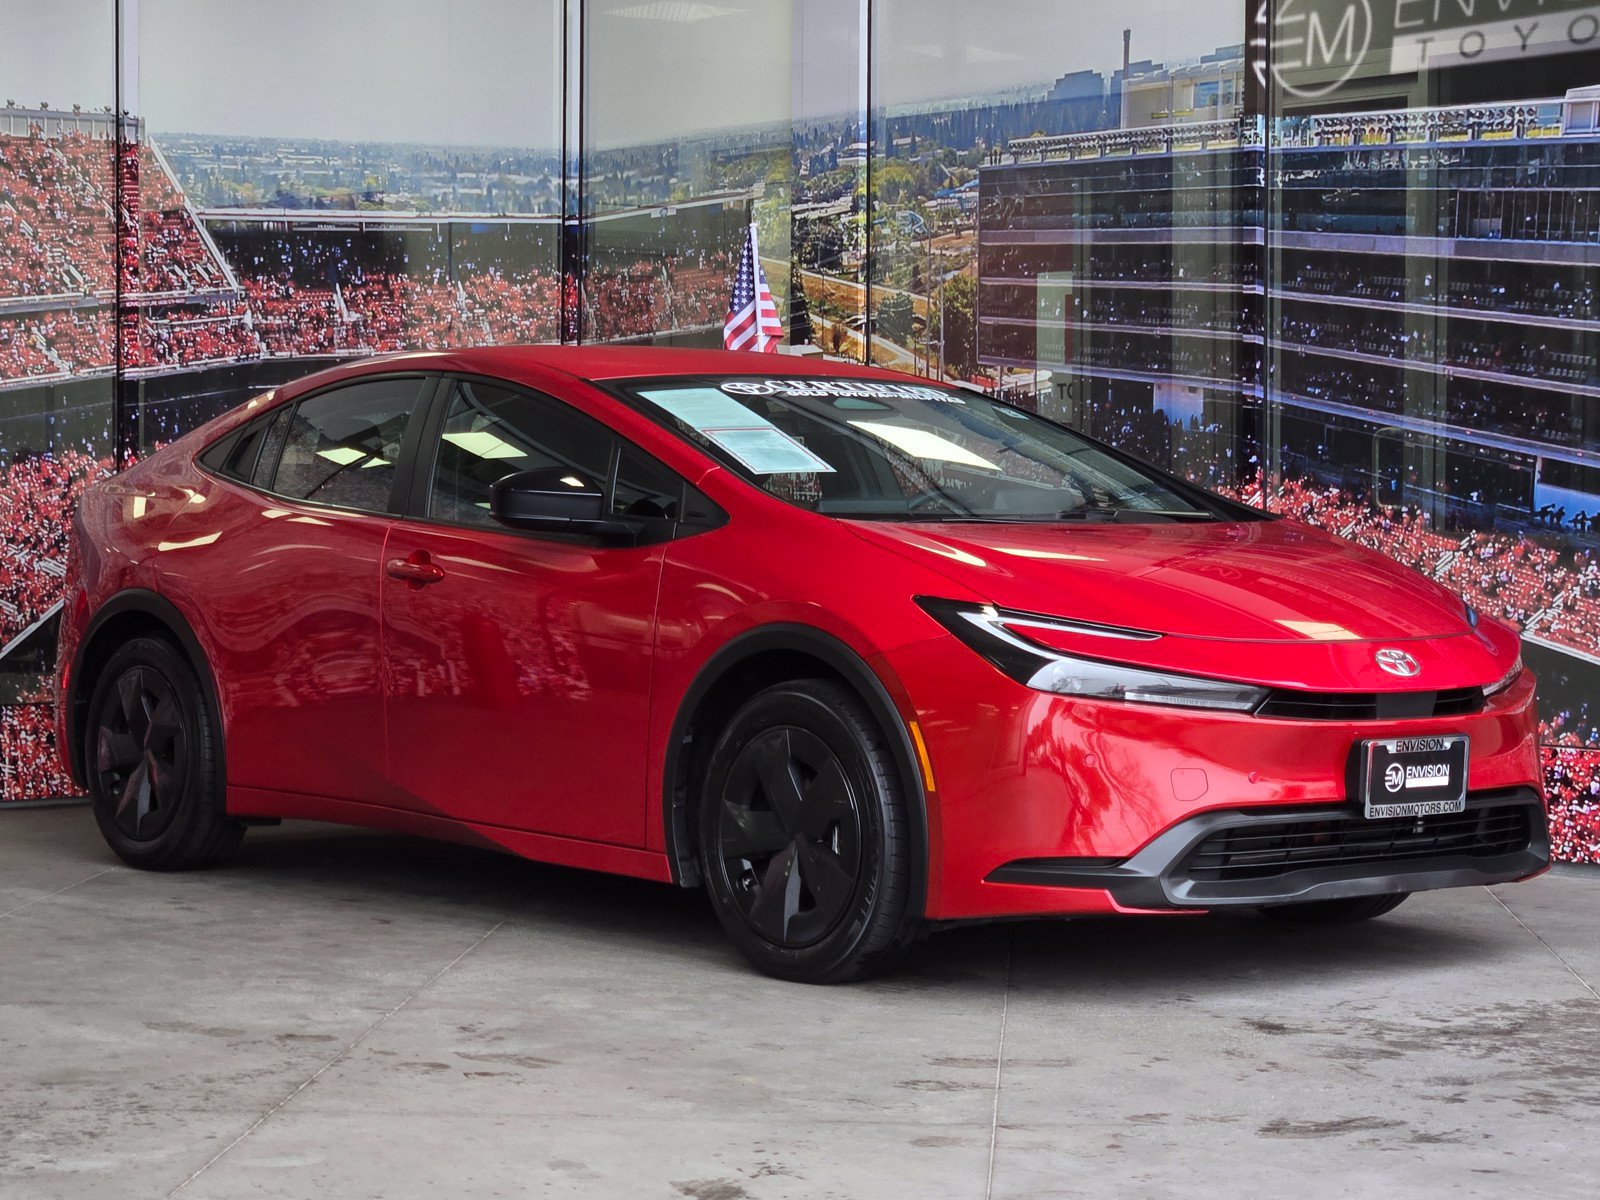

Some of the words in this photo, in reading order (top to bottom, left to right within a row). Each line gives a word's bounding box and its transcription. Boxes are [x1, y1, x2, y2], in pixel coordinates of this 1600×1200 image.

[1415, 14, 1599, 63] TOYO
[1395, 738, 1444, 752] ENVISION
[1406, 763, 1450, 779] ENVISION
[1369, 801, 1462, 818] ENVISIONMOTORS.COM
